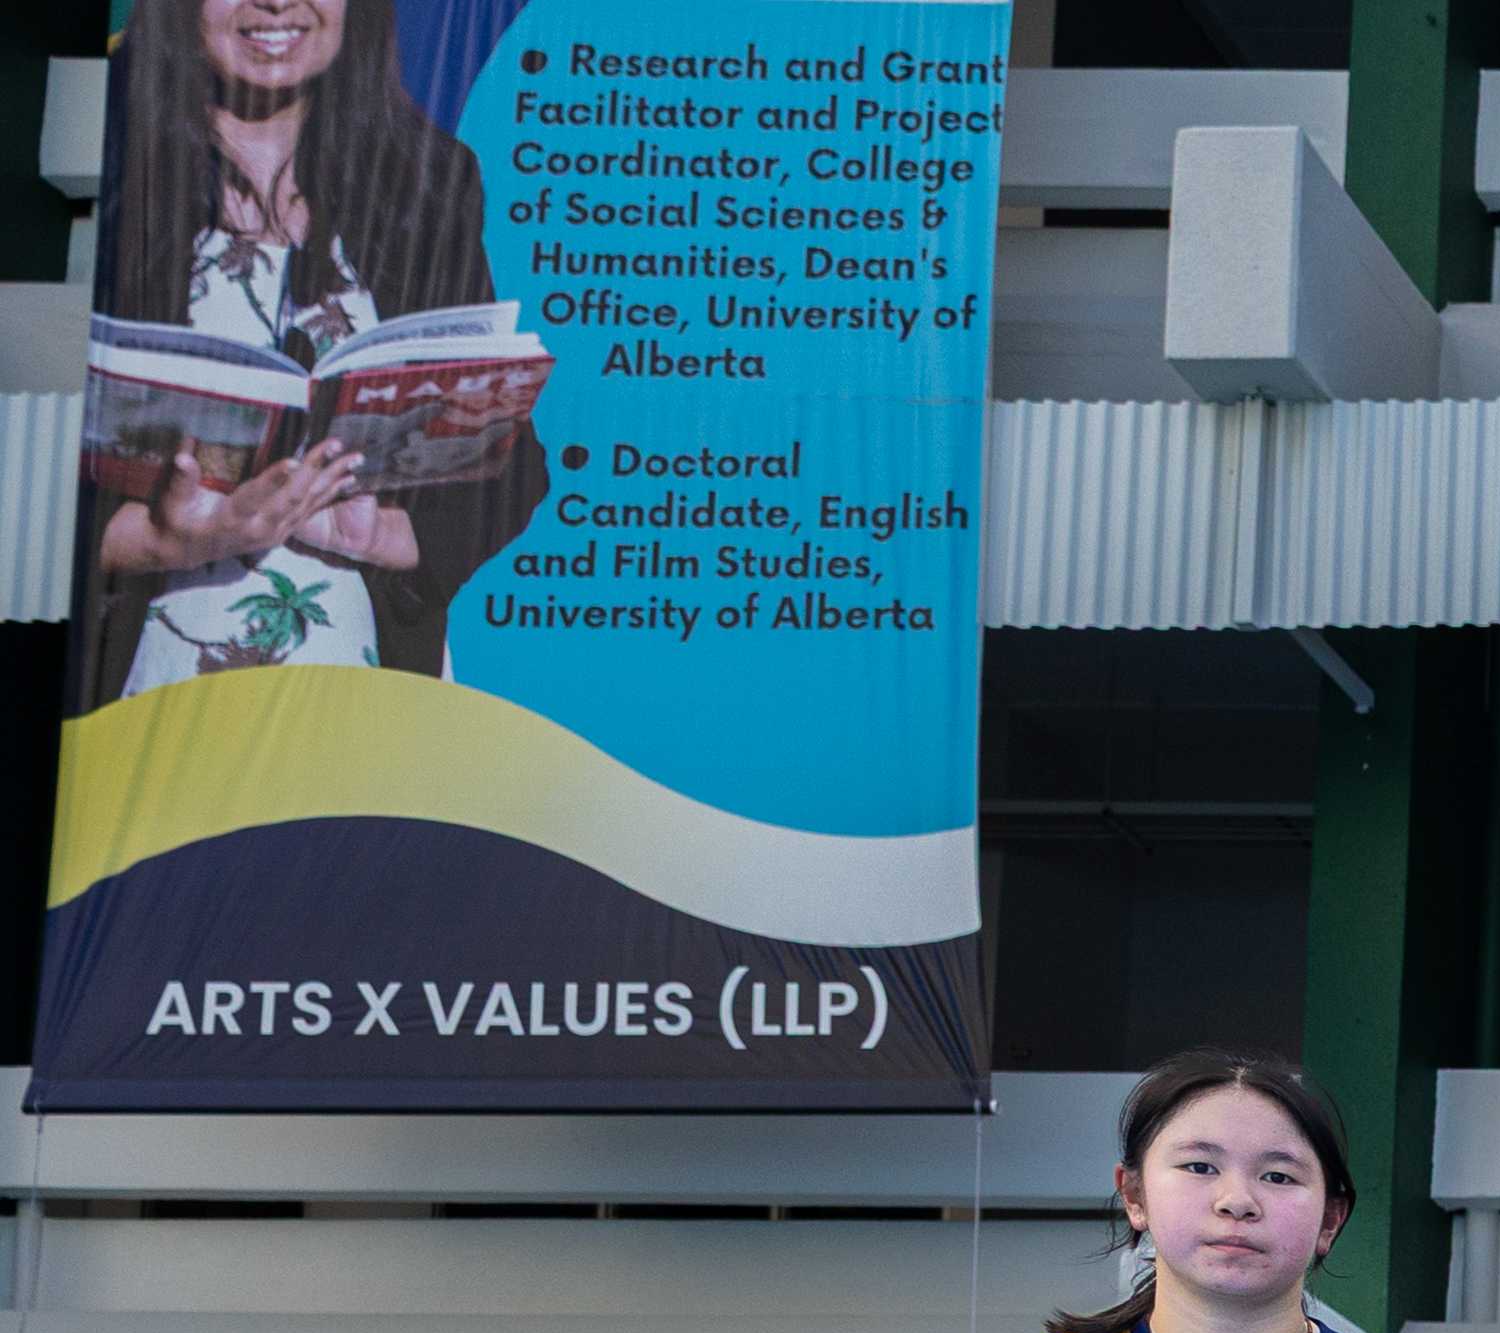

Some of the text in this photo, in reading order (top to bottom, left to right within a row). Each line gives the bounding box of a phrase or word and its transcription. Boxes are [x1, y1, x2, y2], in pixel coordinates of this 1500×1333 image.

[570, 42, 1004, 85] Research and Grant
[515, 89, 1003, 145] Facilitator and Project
[511, 139, 974, 195] Coordinator, College
[508, 187, 948, 232] of Social Sciences &
[531, 240, 948, 285] Humanities, Dean's
[541, 287, 978, 343] Office, University of
[601, 338, 766, 379] Alberta
[612, 440, 801, 479] Doctoral
[556, 489, 969, 543] Candidate, English
[513, 539, 883, 586] and Film Studies,
[485, 591, 935, 643] University of Alberta
[146, 965, 888, 1050] ARTS X VALUES (LLP)
